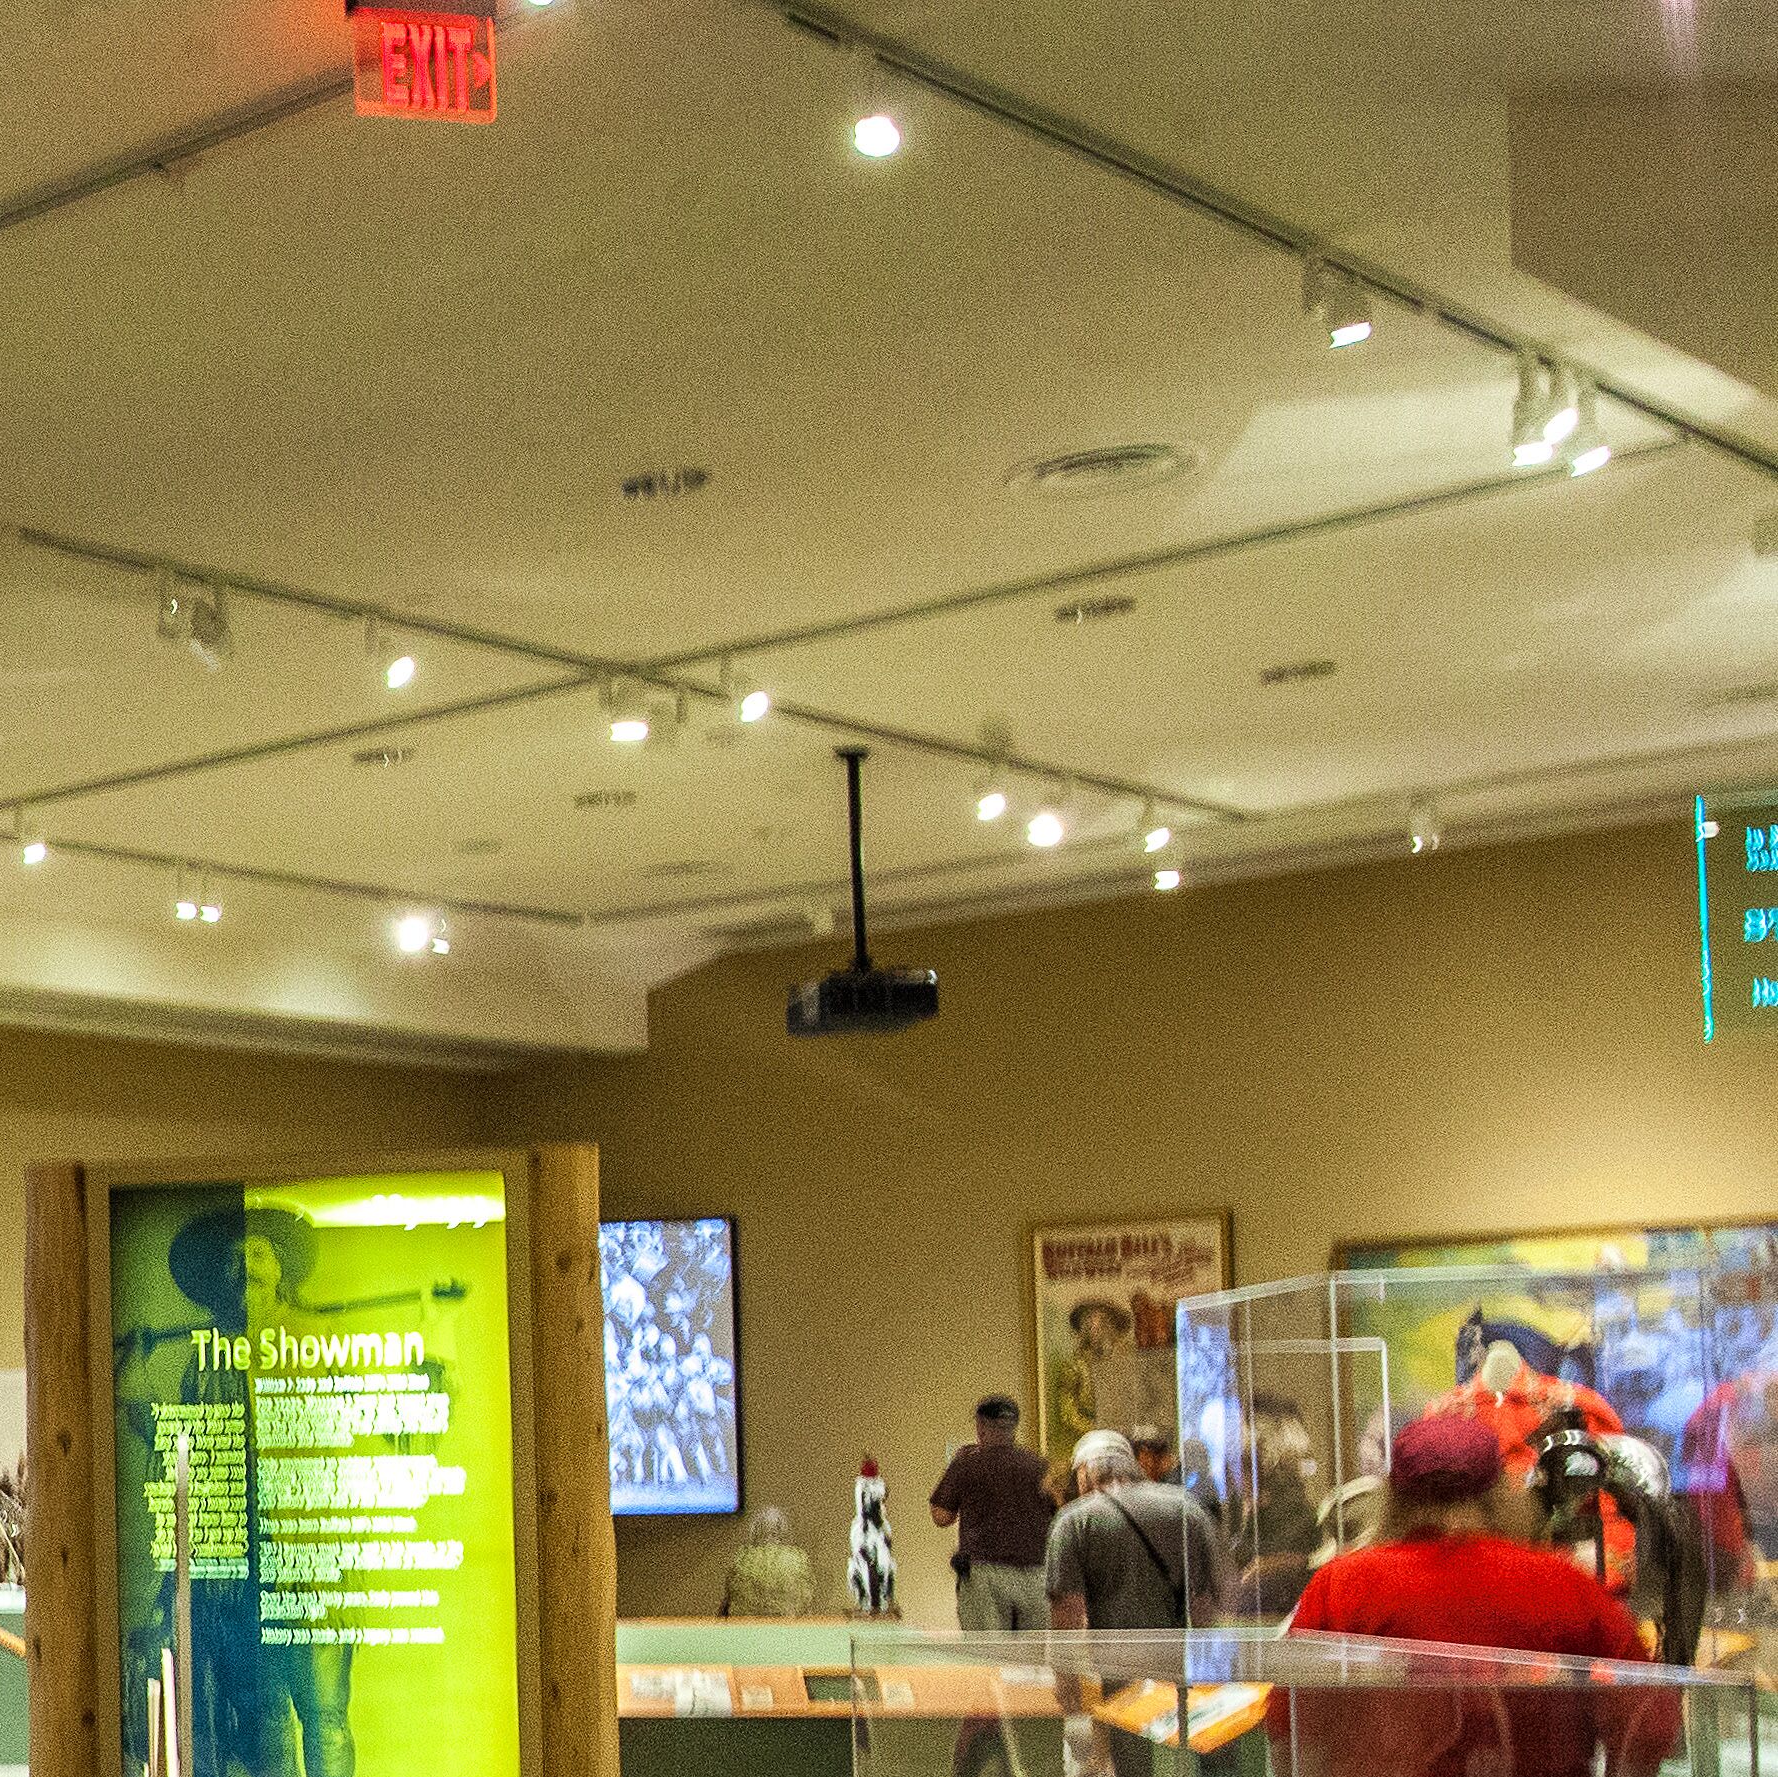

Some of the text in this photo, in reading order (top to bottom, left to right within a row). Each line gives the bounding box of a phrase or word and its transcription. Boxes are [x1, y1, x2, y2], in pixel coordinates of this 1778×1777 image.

[381, 21, 473, 112] EXIT
[191, 1326, 425, 1371] The Showman
